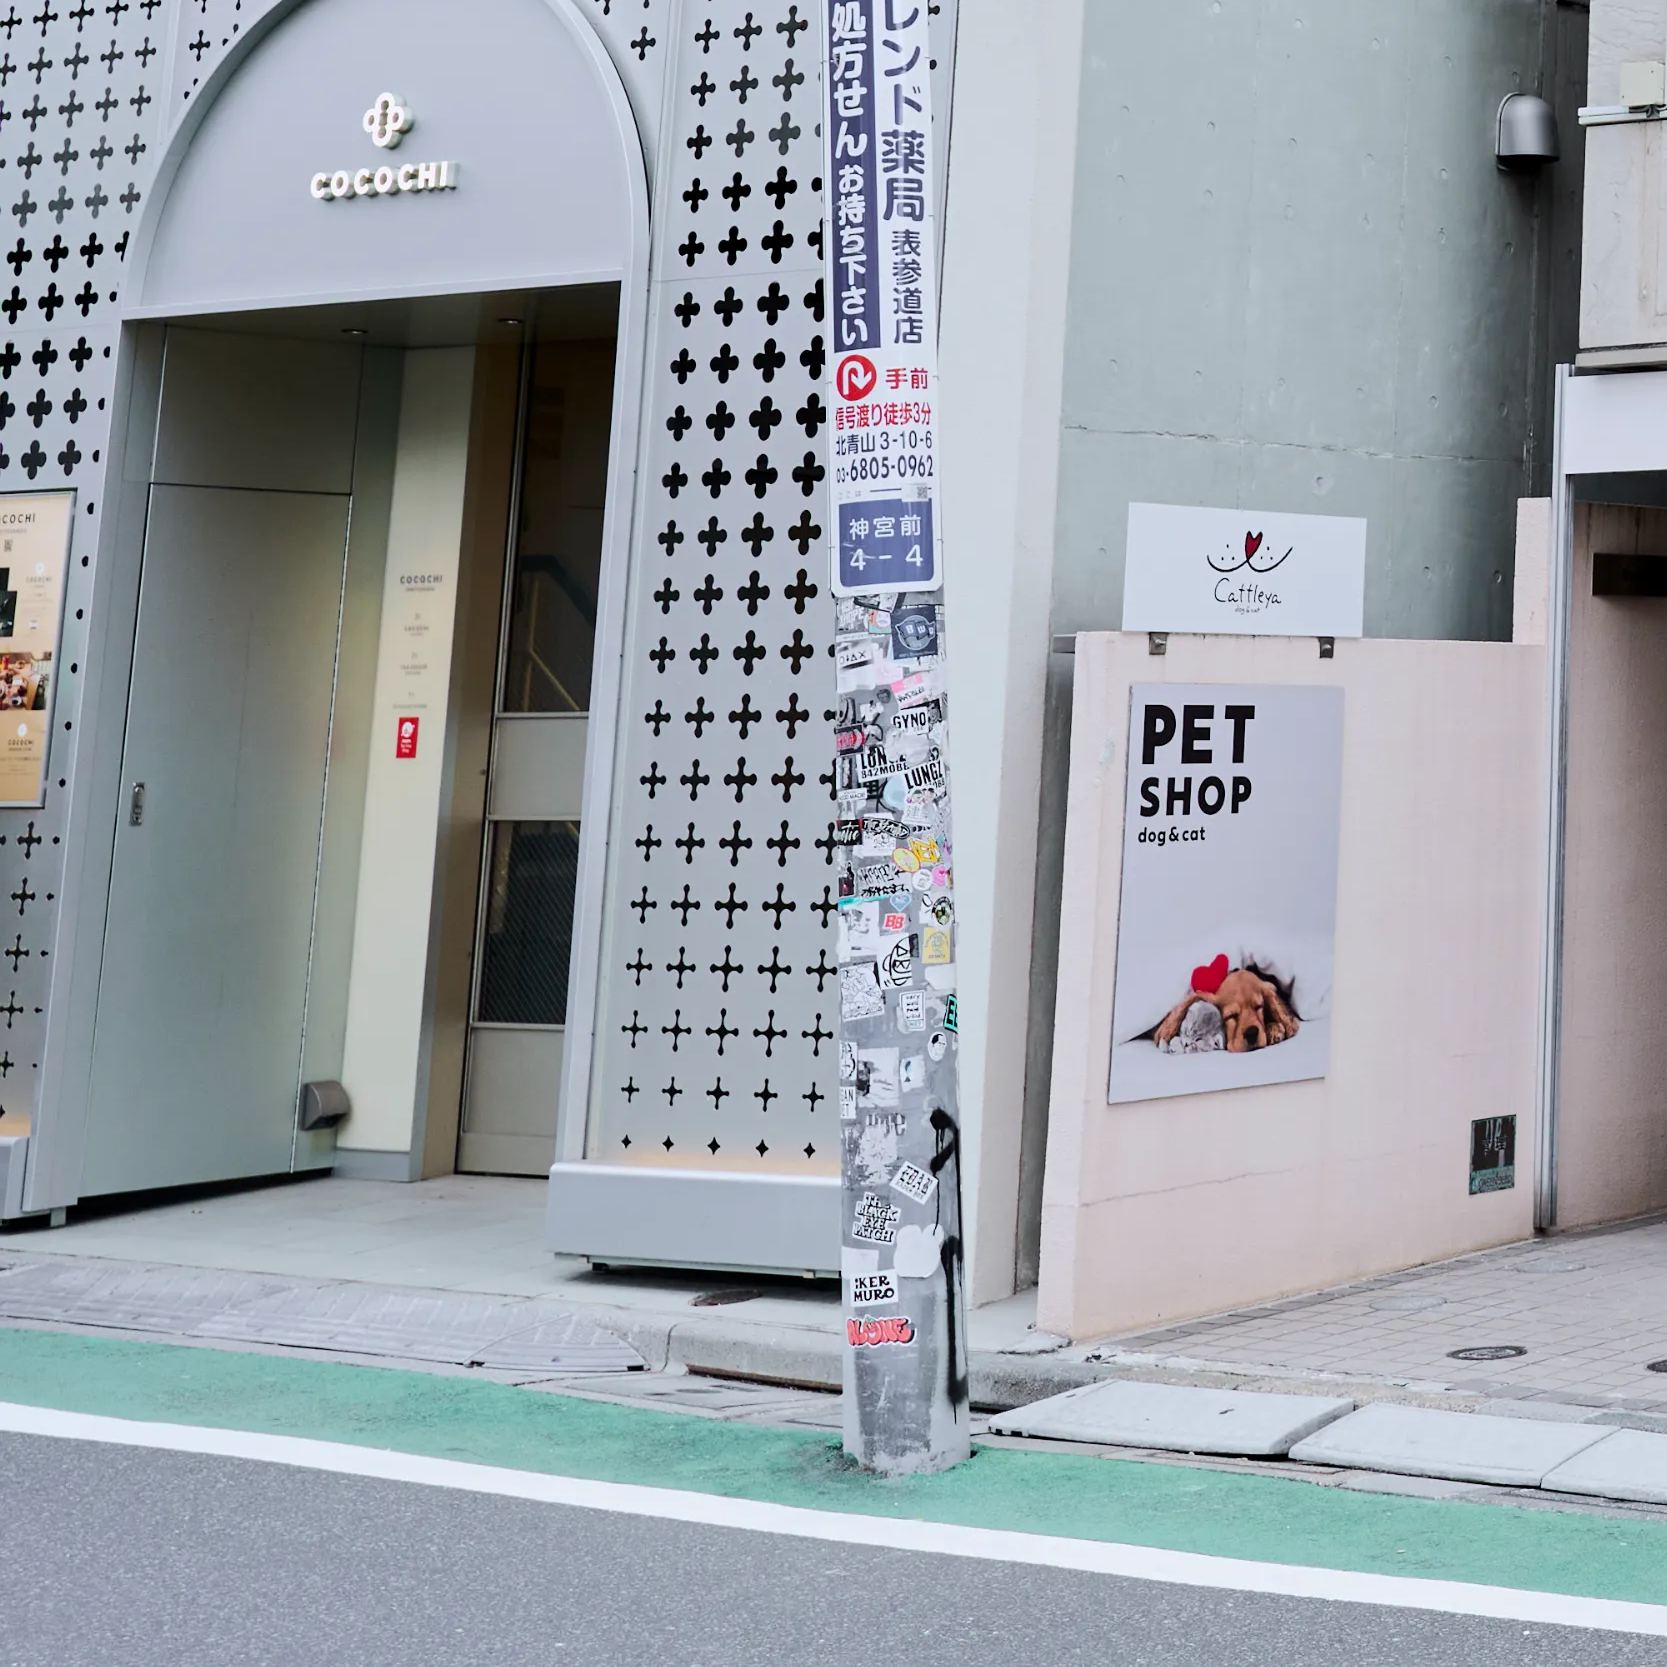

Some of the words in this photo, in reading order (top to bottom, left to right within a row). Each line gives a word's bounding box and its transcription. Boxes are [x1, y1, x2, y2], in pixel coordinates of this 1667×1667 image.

[310, 160, 455, 200] COCOCHI
[891, 229, 924, 344] 表参道店
[886, 368, 928, 389] 手前
[835, 402, 931, 430] 信号渡り徒歩3分
[0, 513, 36, 525] COCHI
[850, 515, 921, 540] 神宮前
[850, 544, 924, 571] 4-4
[400, 575, 443, 584] COCOCHI
[1214, 577, 1281, 608] Cattleya
[1142, 704, 1255, 764] PET
[1140, 776, 1252, 817] SHOP
[857, 1203, 899, 1222] BLACK
[862, 1218, 886, 1230] EYE
[854, 1222, 894, 1242] PATCH
[854, 1287, 895, 1302] MURO
